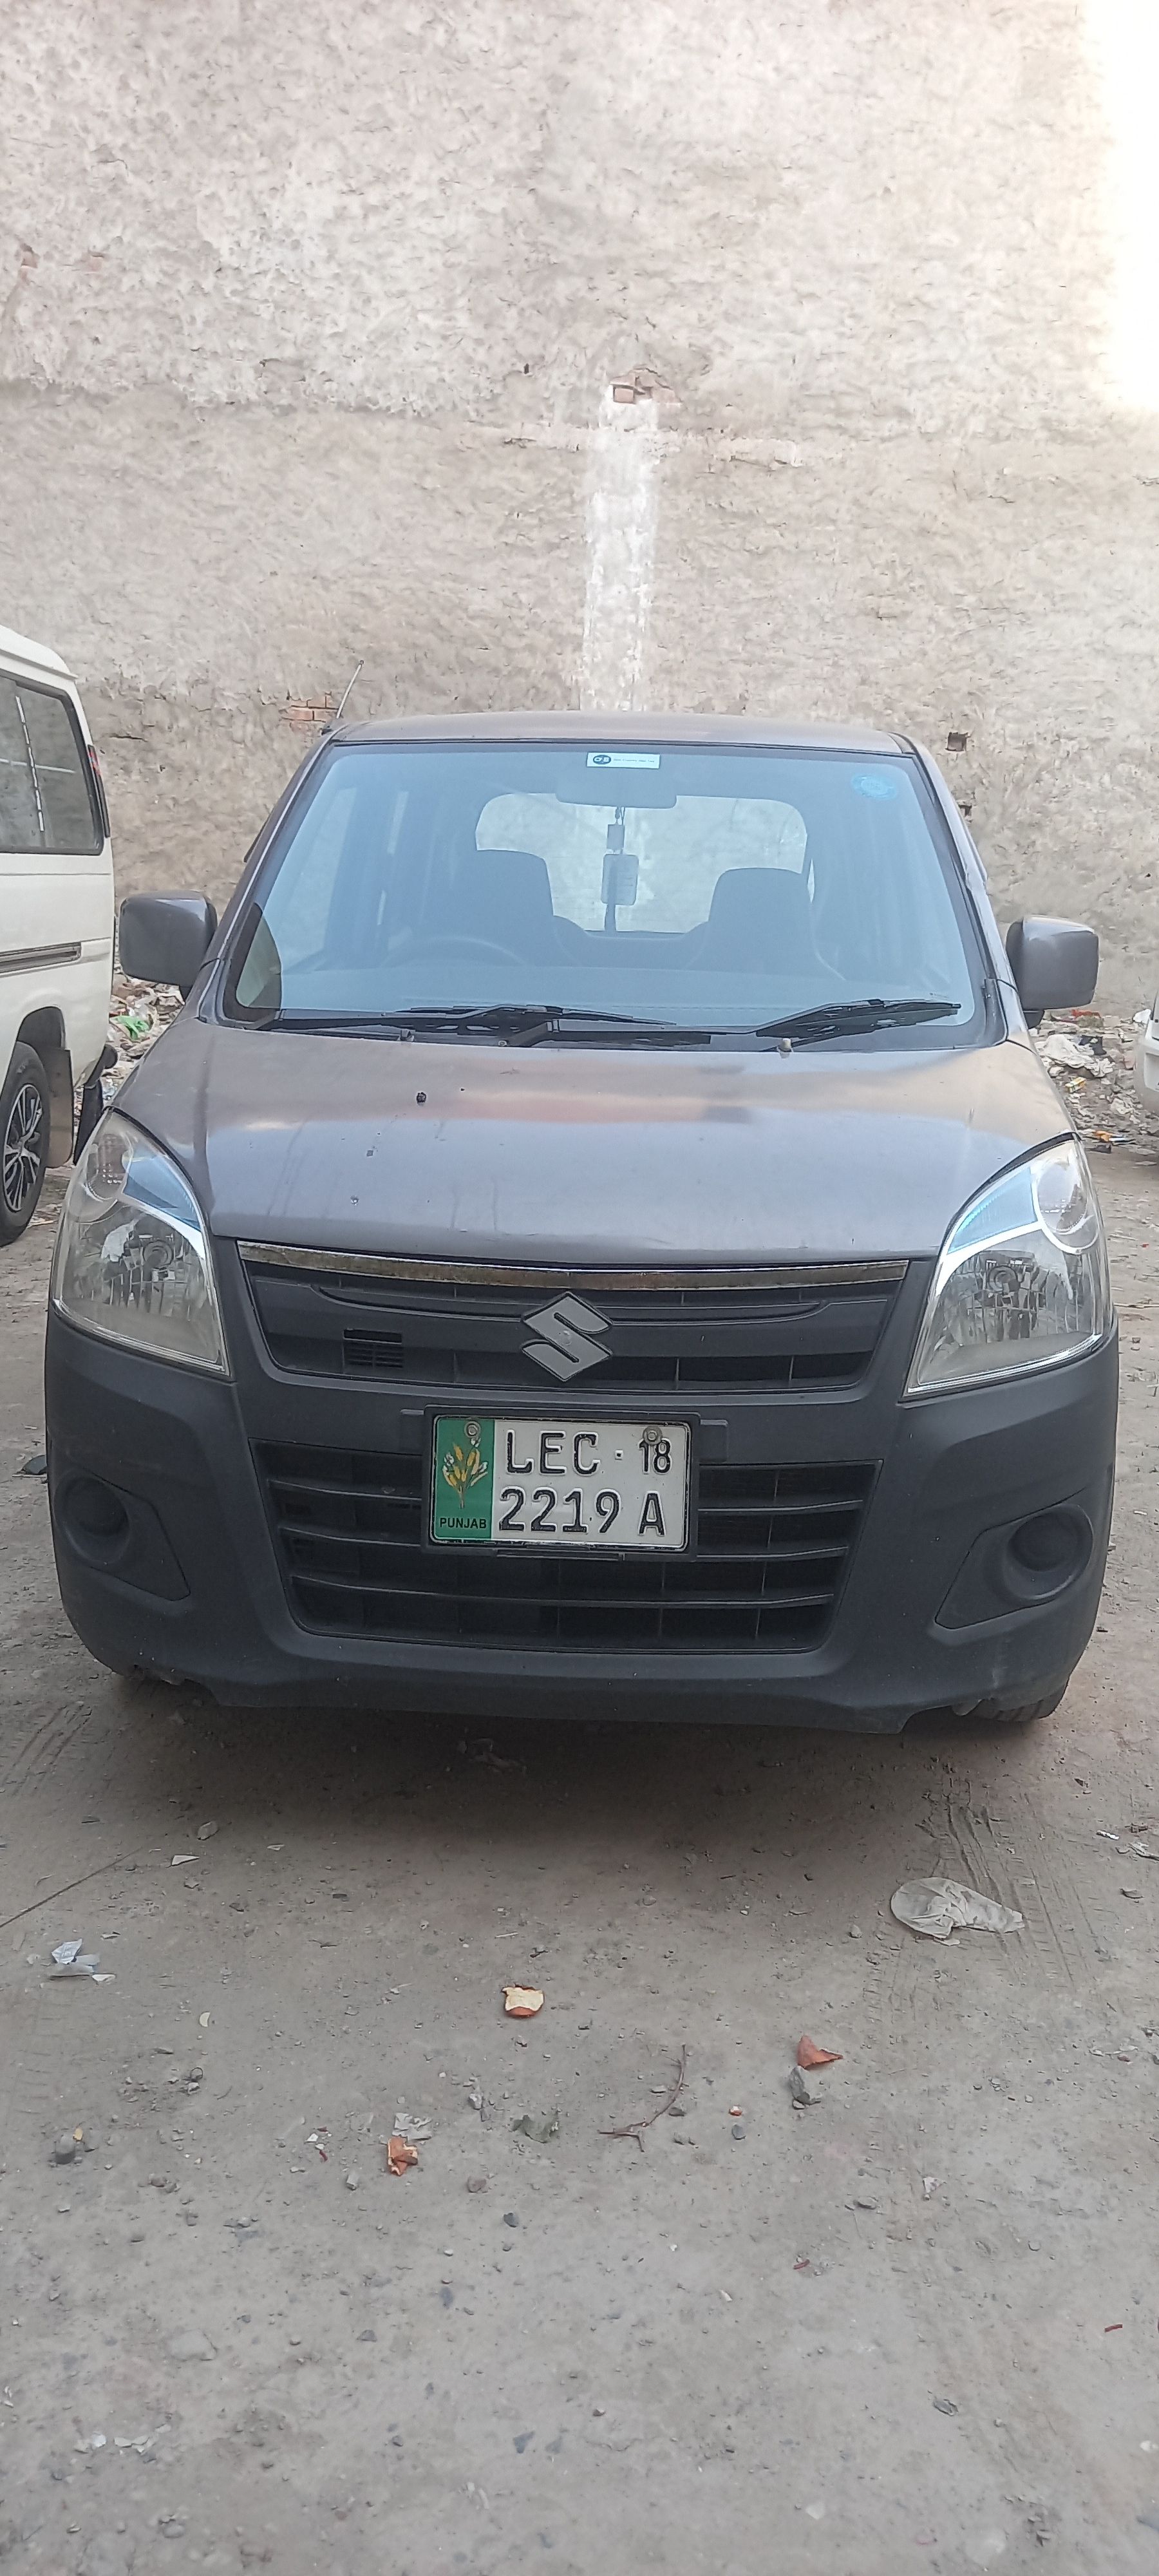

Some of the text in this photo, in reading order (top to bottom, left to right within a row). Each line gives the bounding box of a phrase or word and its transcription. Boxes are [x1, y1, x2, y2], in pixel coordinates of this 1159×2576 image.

[506, 1430, 672, 1476] LEC 18
[440, 1517, 487, 1529] PUNJAB
[499, 1487, 666, 1536] 2219 A
